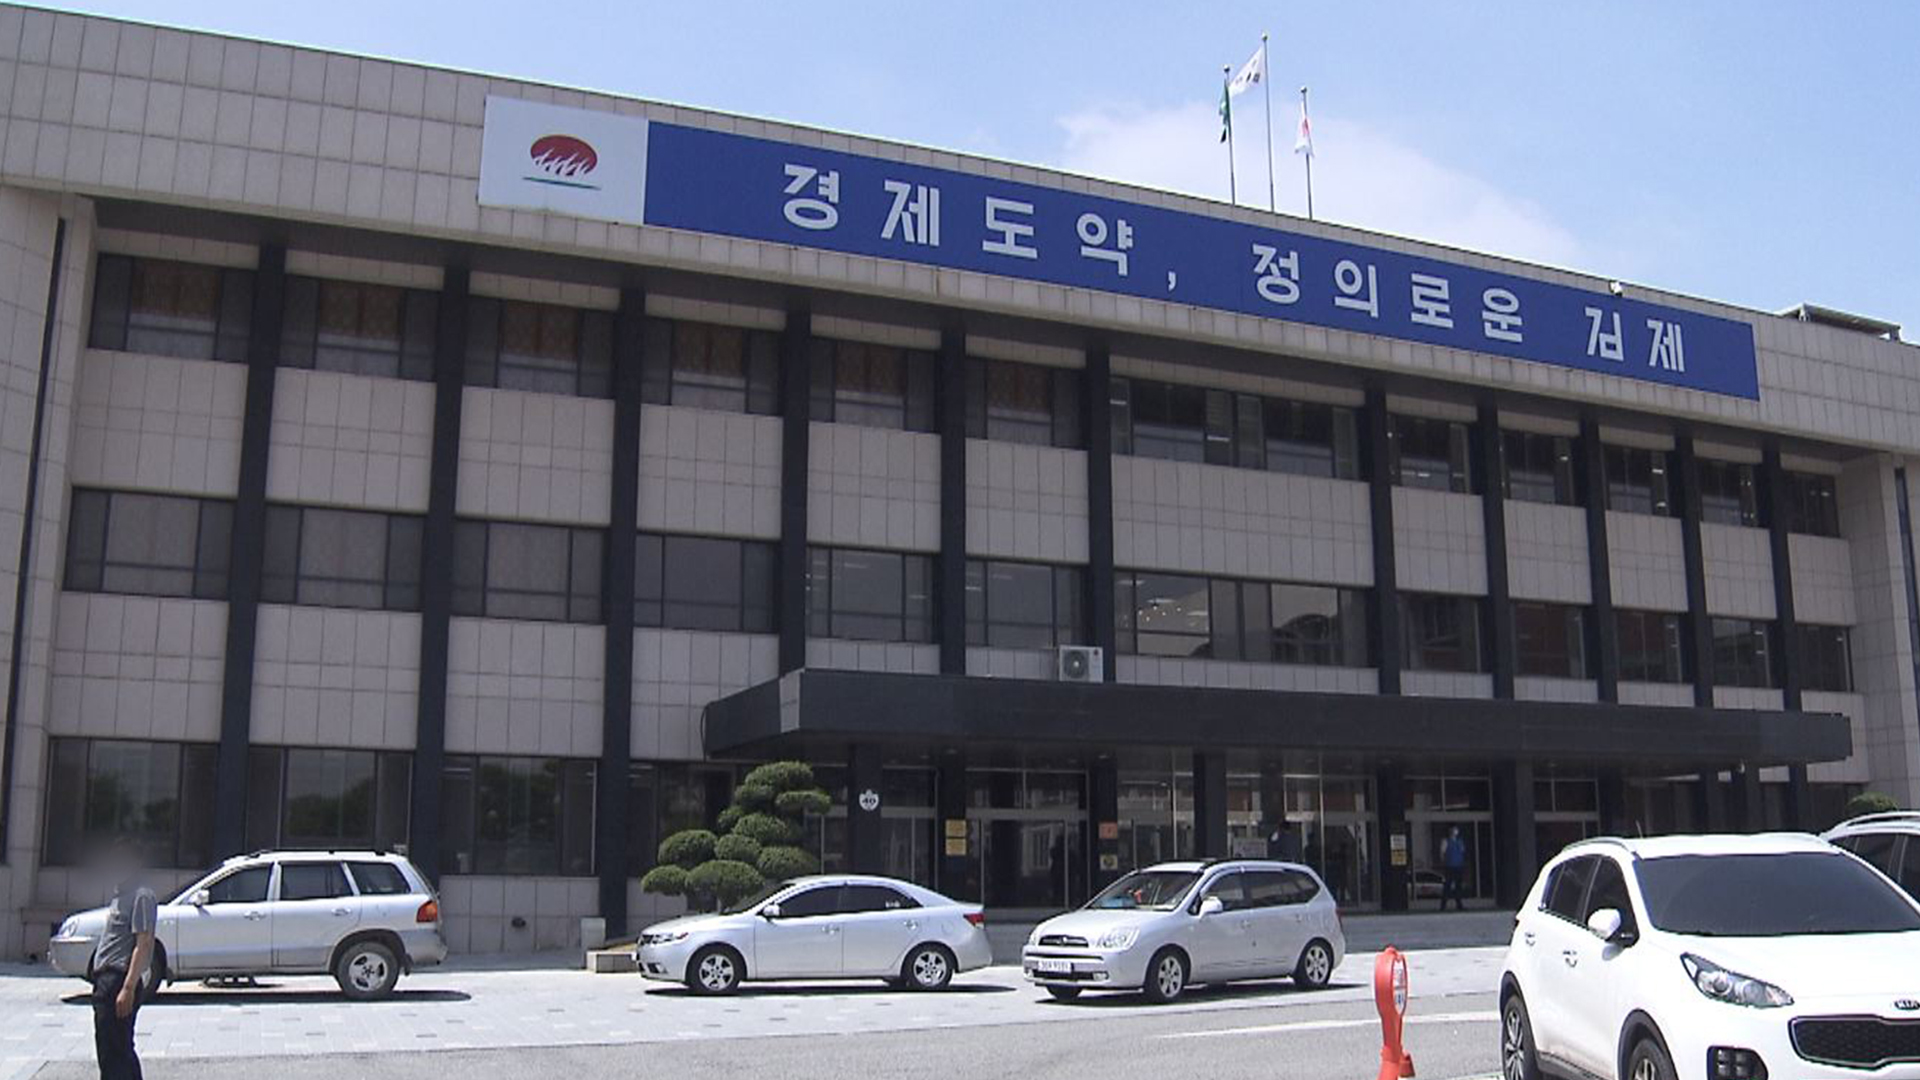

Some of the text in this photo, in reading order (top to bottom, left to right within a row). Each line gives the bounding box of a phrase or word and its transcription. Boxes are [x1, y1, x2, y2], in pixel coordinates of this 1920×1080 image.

[783, 163, 1686, 373] 경제도약, 정의로운 김제
